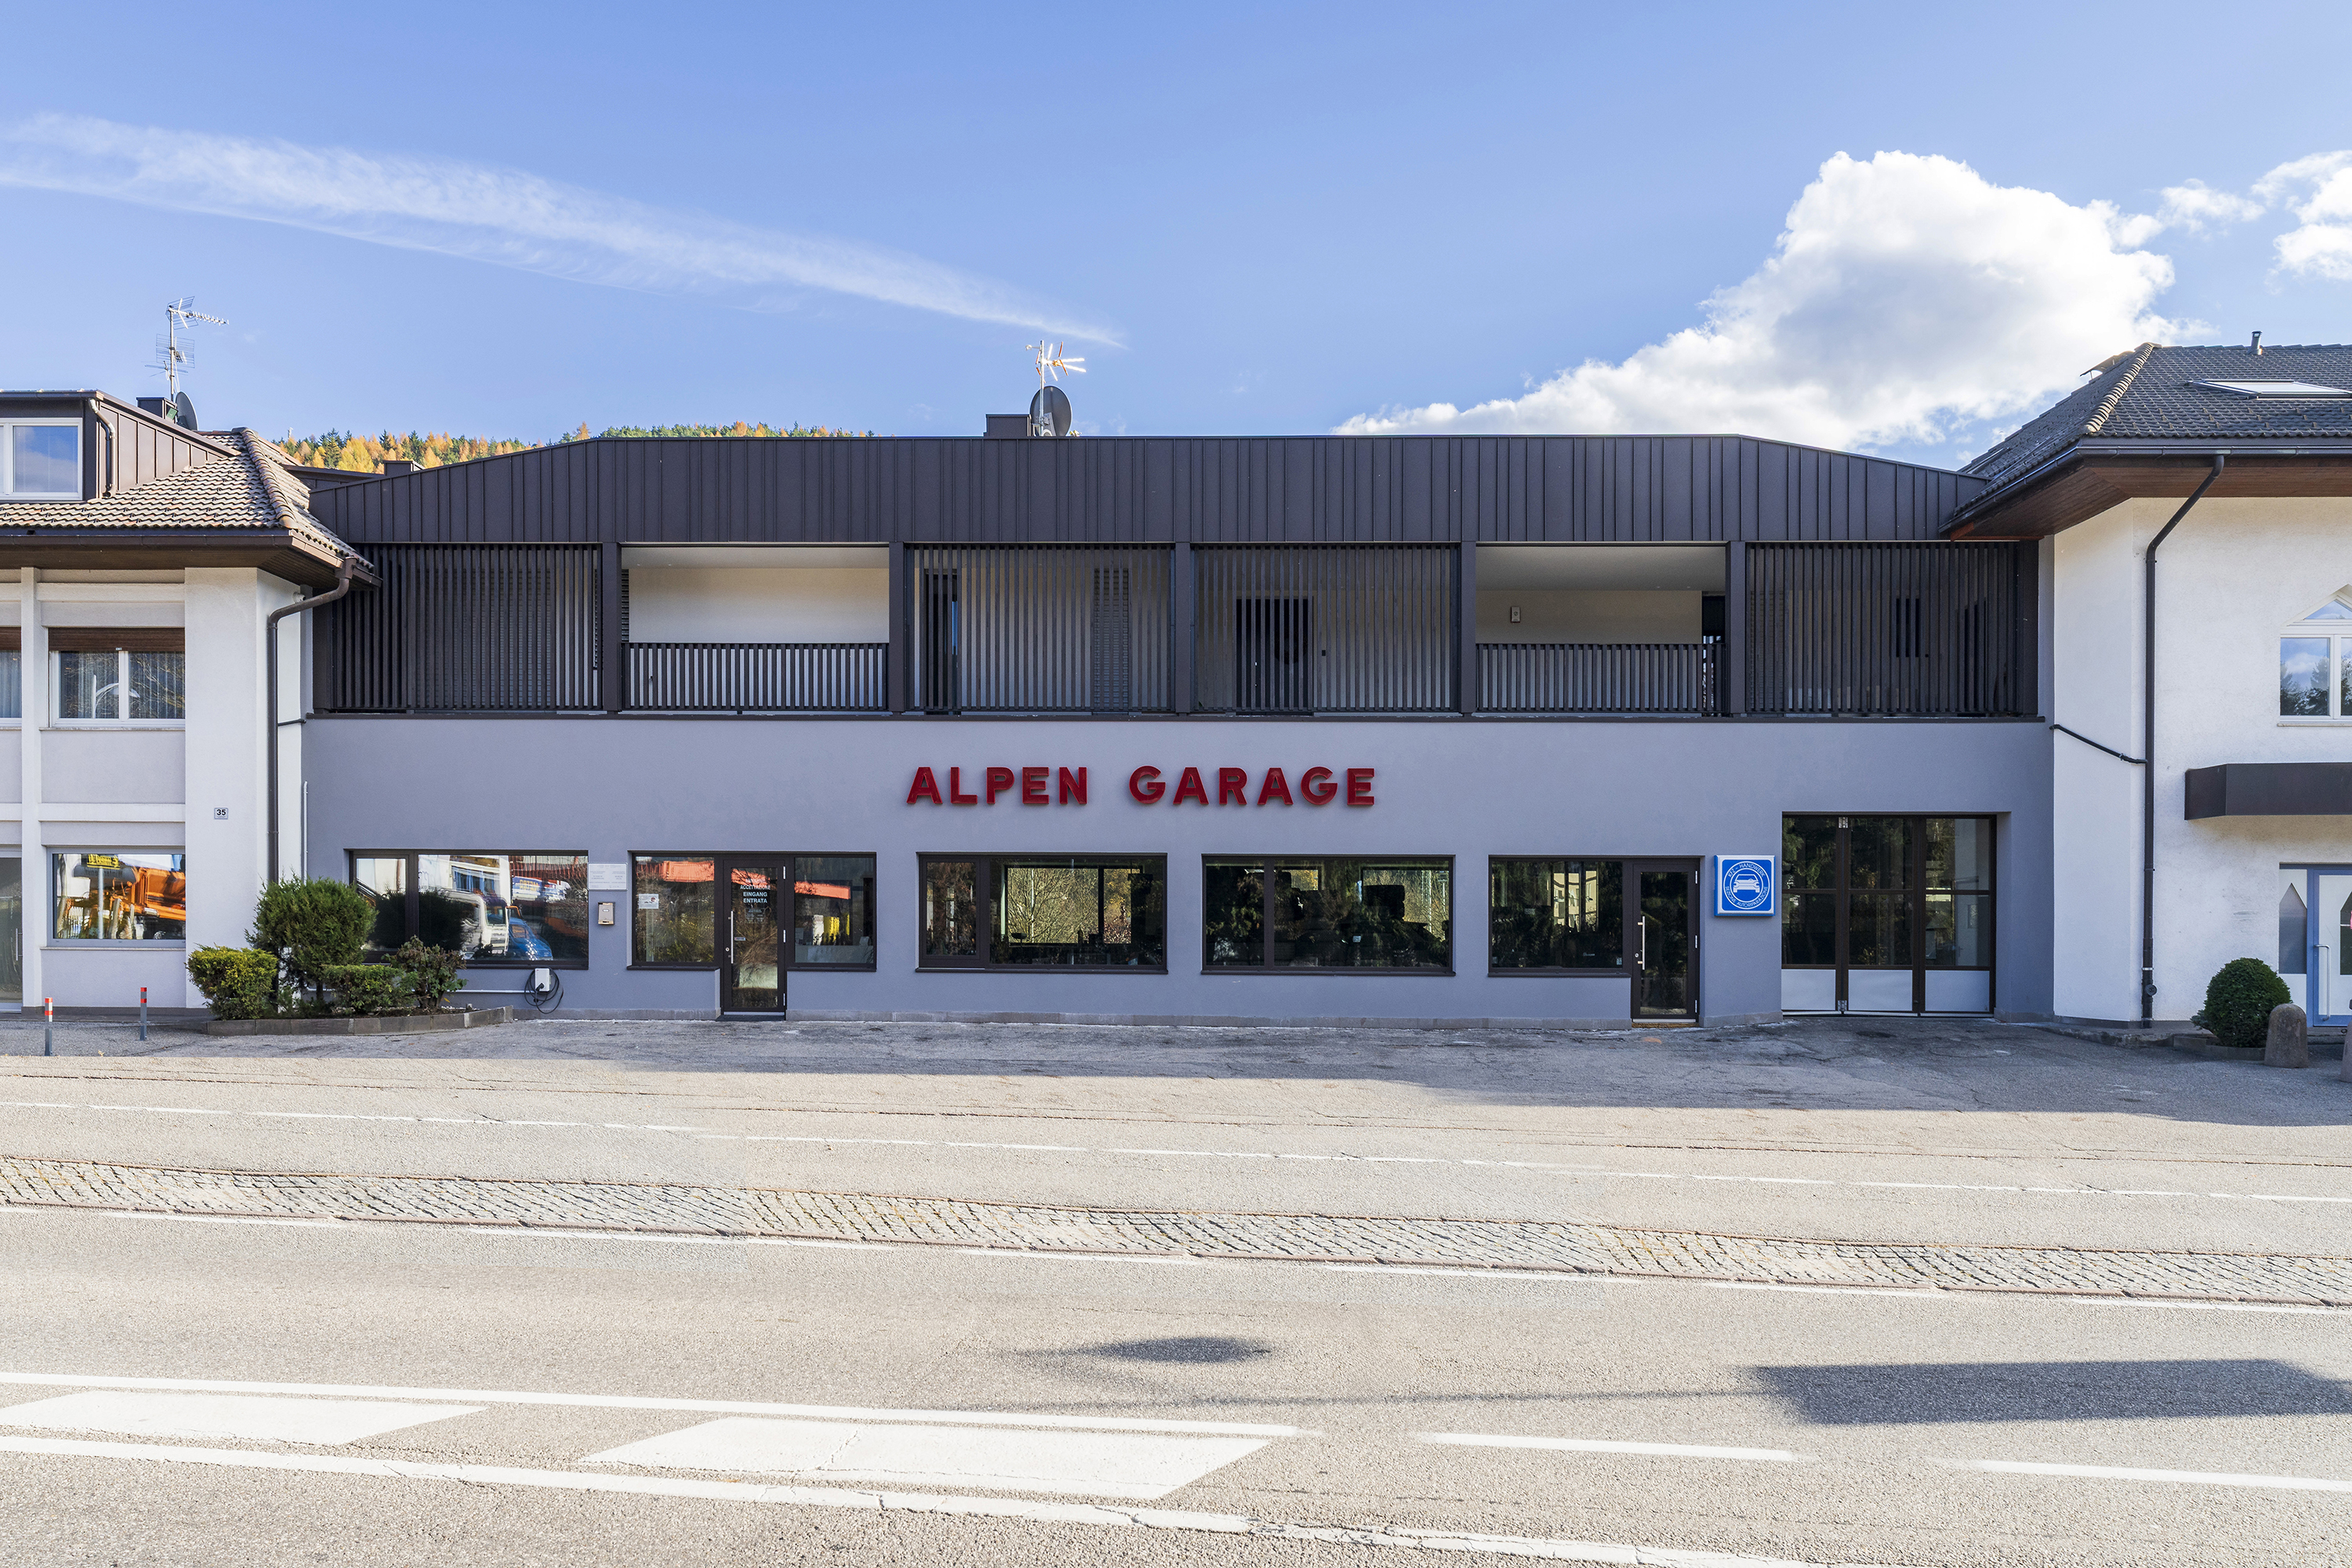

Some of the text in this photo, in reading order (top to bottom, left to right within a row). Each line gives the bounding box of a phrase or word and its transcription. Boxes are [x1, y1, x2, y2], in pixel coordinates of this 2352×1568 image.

[906, 764, 1376, 806] ALPEN GARAGE
[1727, 868, 1736, 877] KFZ
[1739, 863, 1766, 877] HANDWERK
[1726, 886, 1768, 907] SEZIONE AUTORIPARAZIONE
